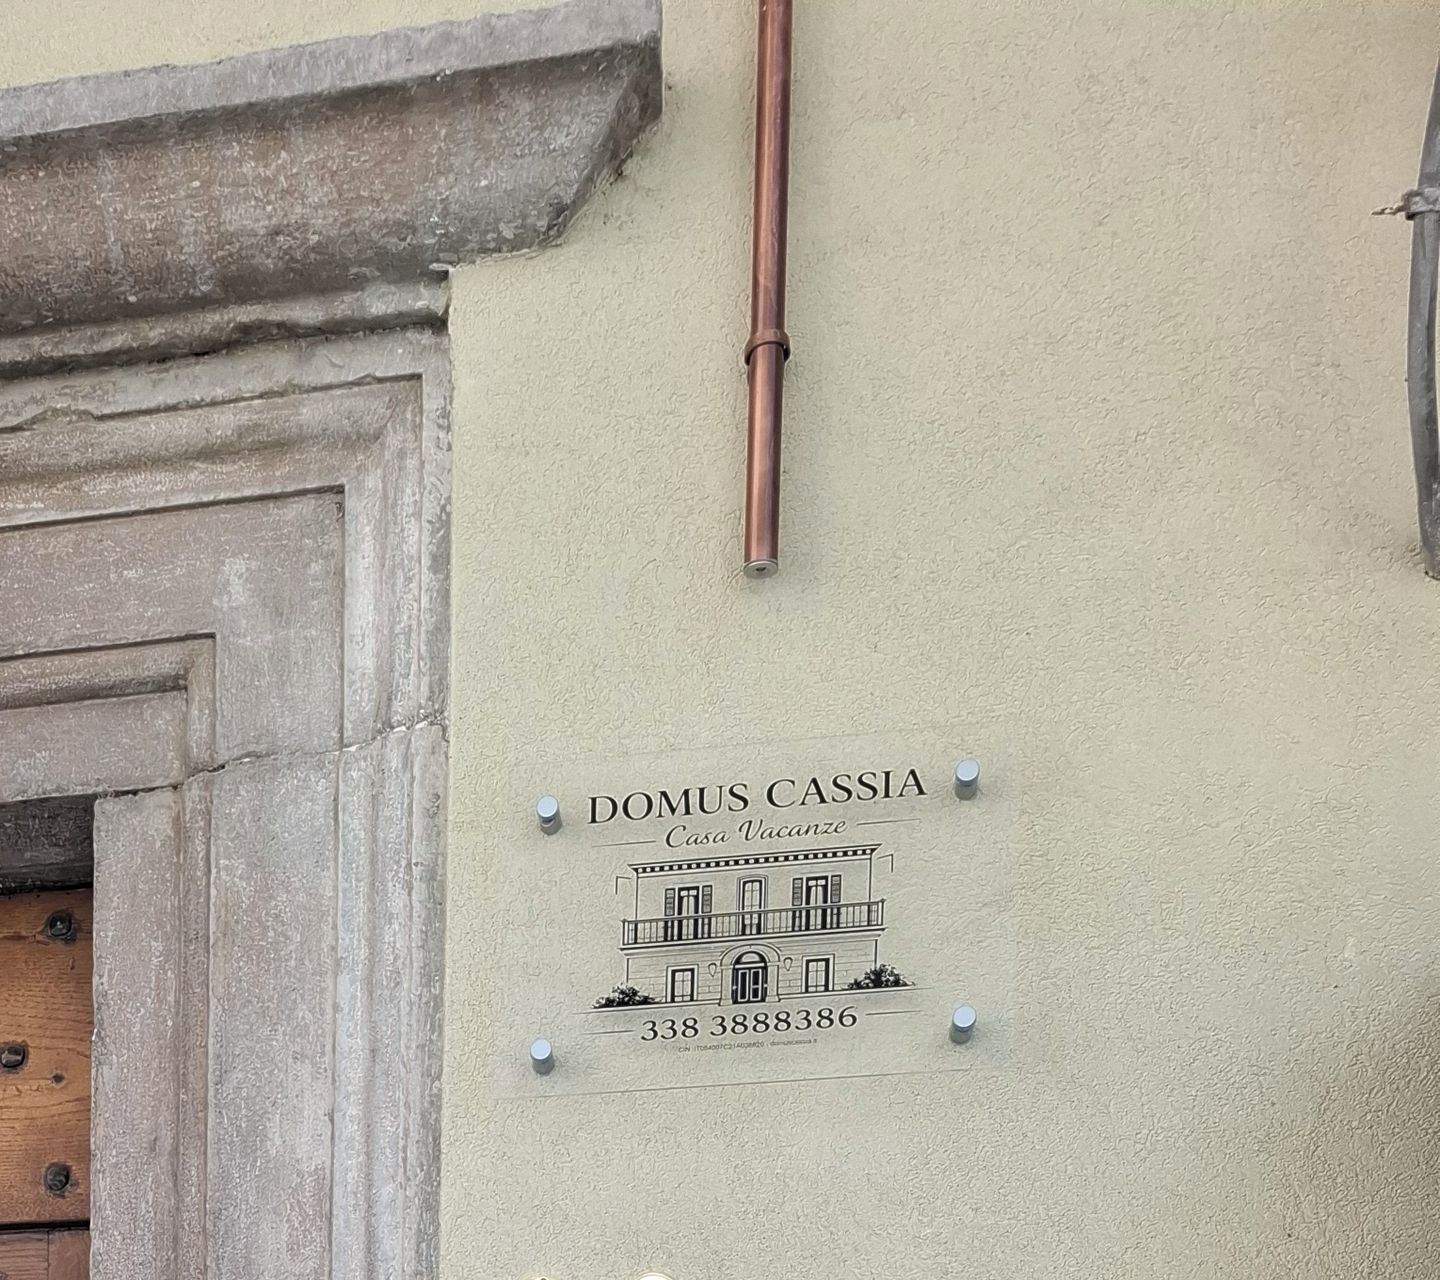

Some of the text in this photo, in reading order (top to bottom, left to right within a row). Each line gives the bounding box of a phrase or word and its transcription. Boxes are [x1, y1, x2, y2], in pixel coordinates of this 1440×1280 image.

[587, 767, 929, 825] DOMUS CASSIA
[664, 818, 849, 849] Casa Vacanze
[640, 1005, 859, 1042] 338 3888386
